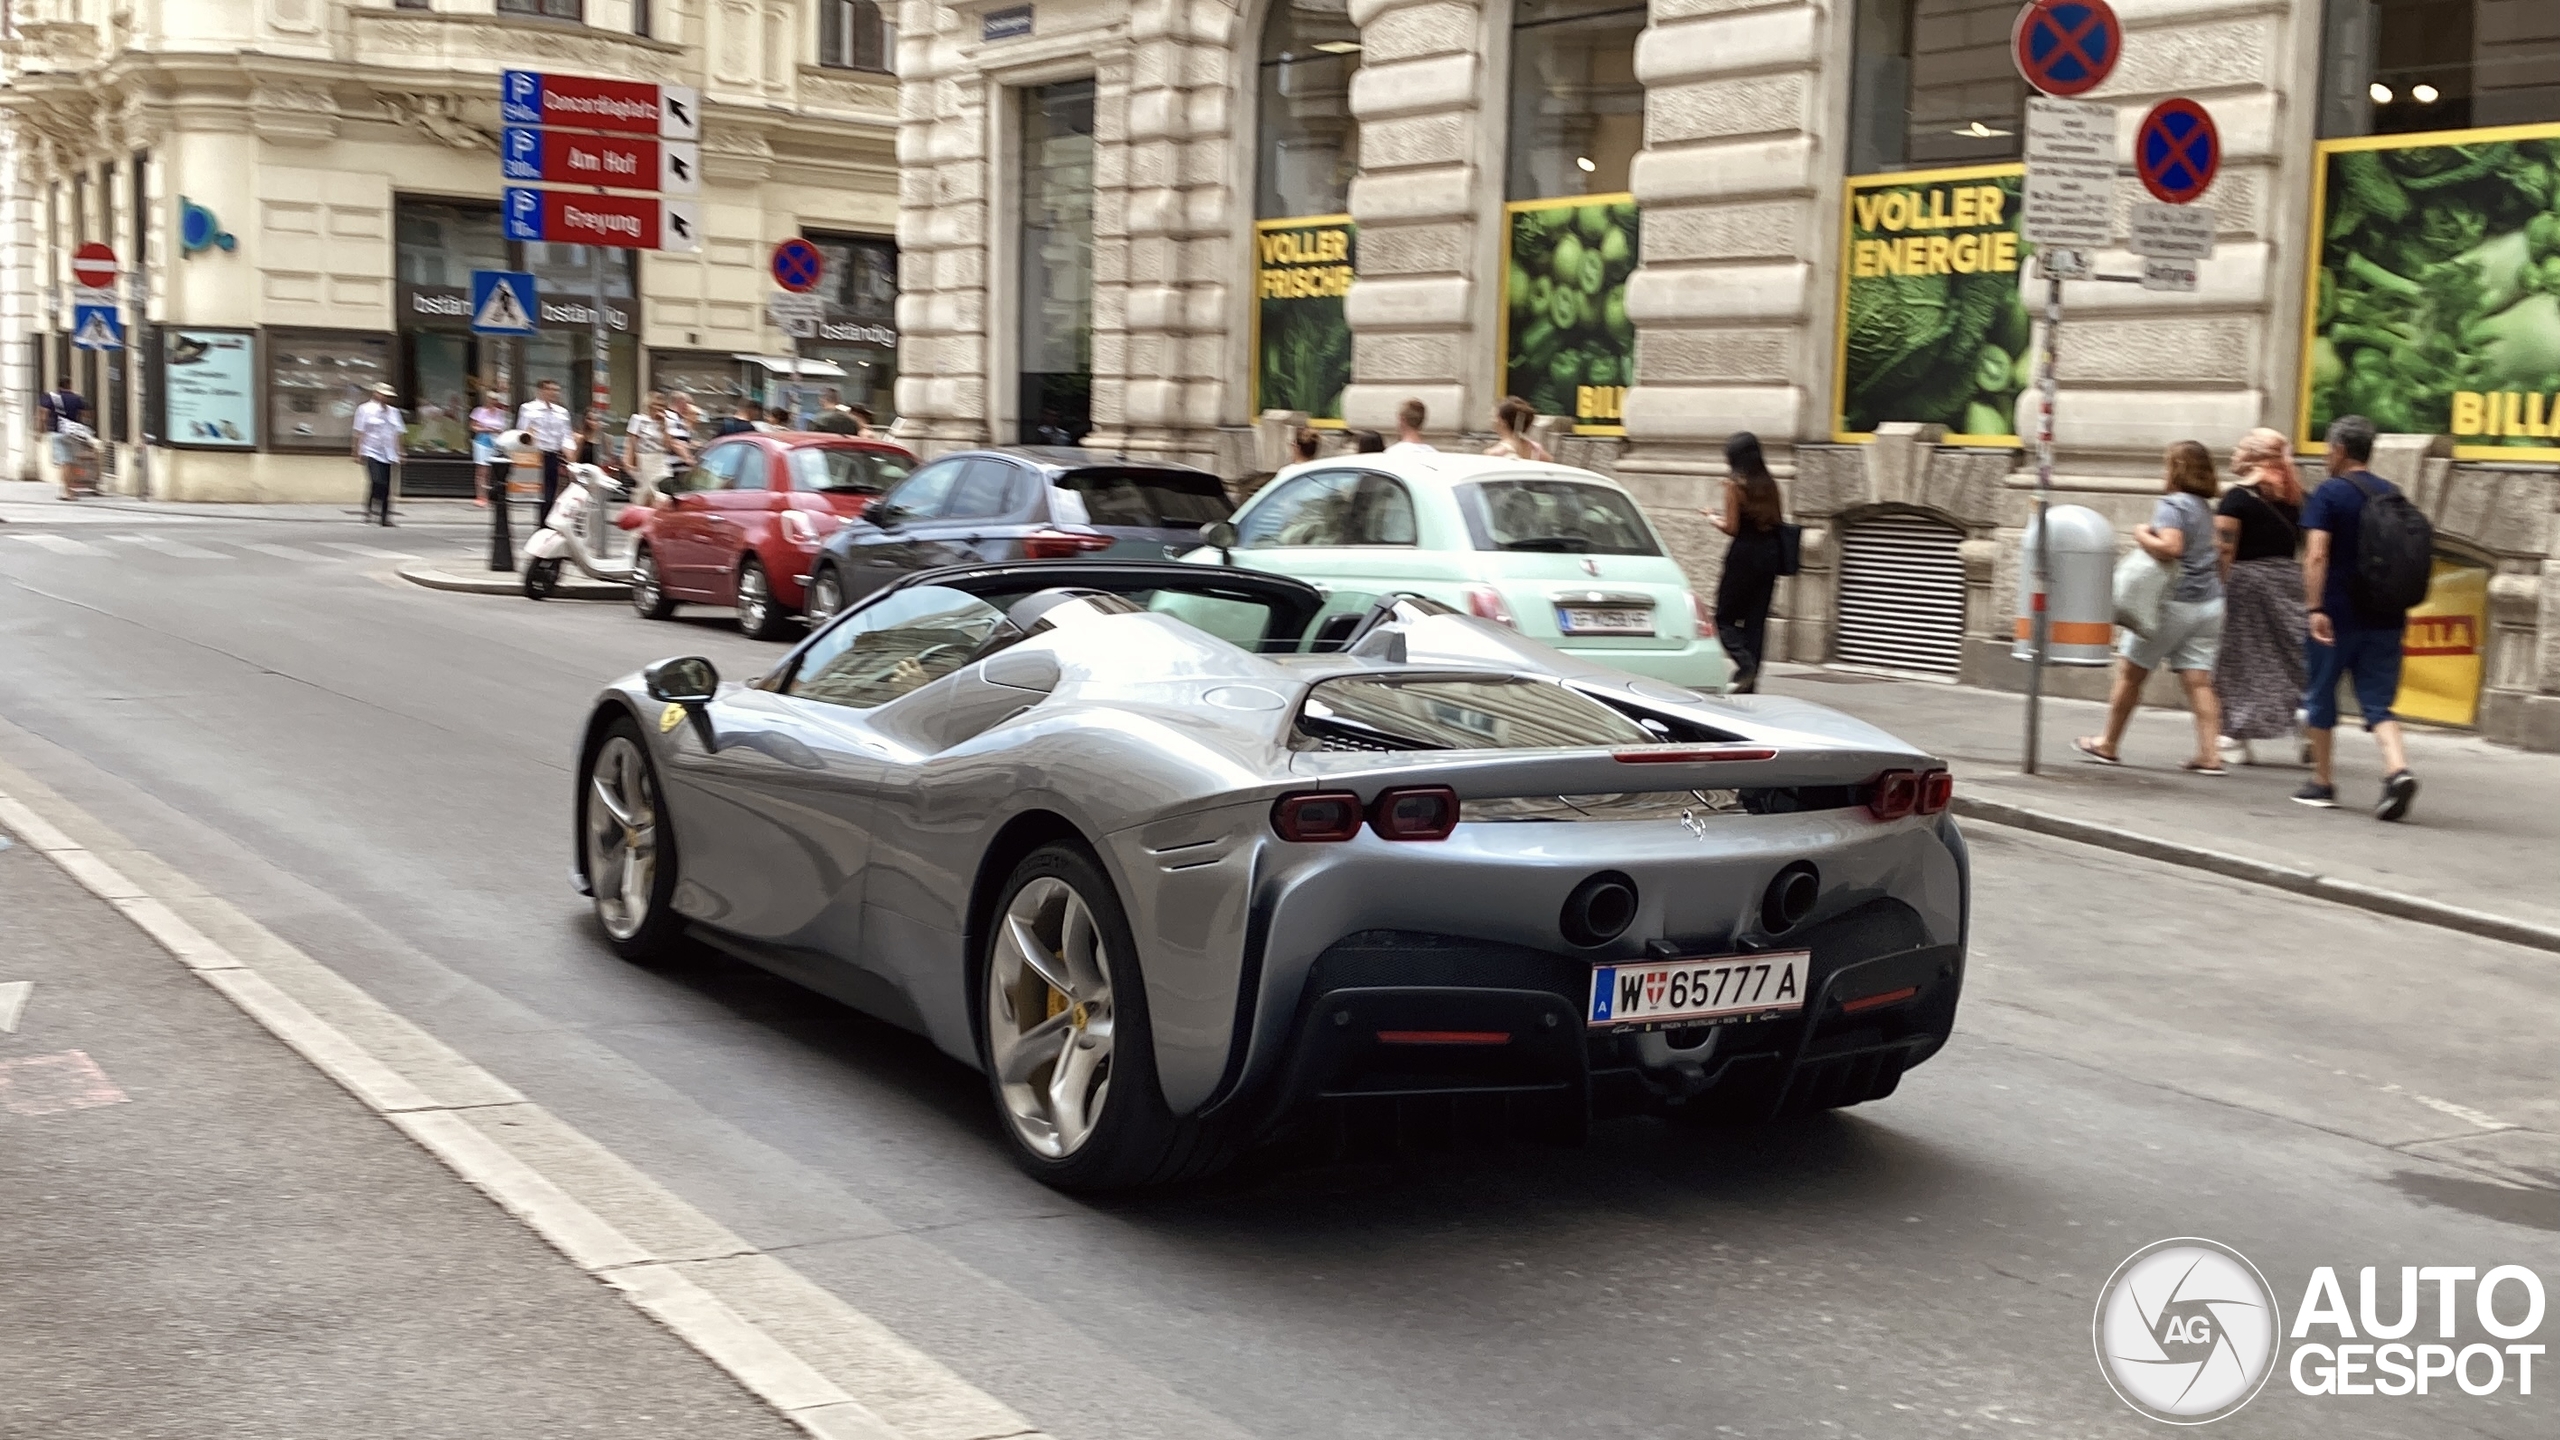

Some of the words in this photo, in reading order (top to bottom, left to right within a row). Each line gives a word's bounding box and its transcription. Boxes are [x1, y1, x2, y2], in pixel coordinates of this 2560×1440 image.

[567, 147, 601, 171] Am
[603, 149, 637, 174] Hof
[564, 205, 642, 238] Freyung
[1856, 185, 2004, 232] VOLLER
[1260, 230, 1349, 264] VOLLER
[1854, 231, 2018, 277] ENERGIE
[1260, 265, 1354, 298] FRISCHE
[1620, 973, 1645, 1013] W
[1670, 964, 1771, 1008] 65777
[1776, 962, 1796, 999] A
[1598, 1001, 1607, 1013] A
